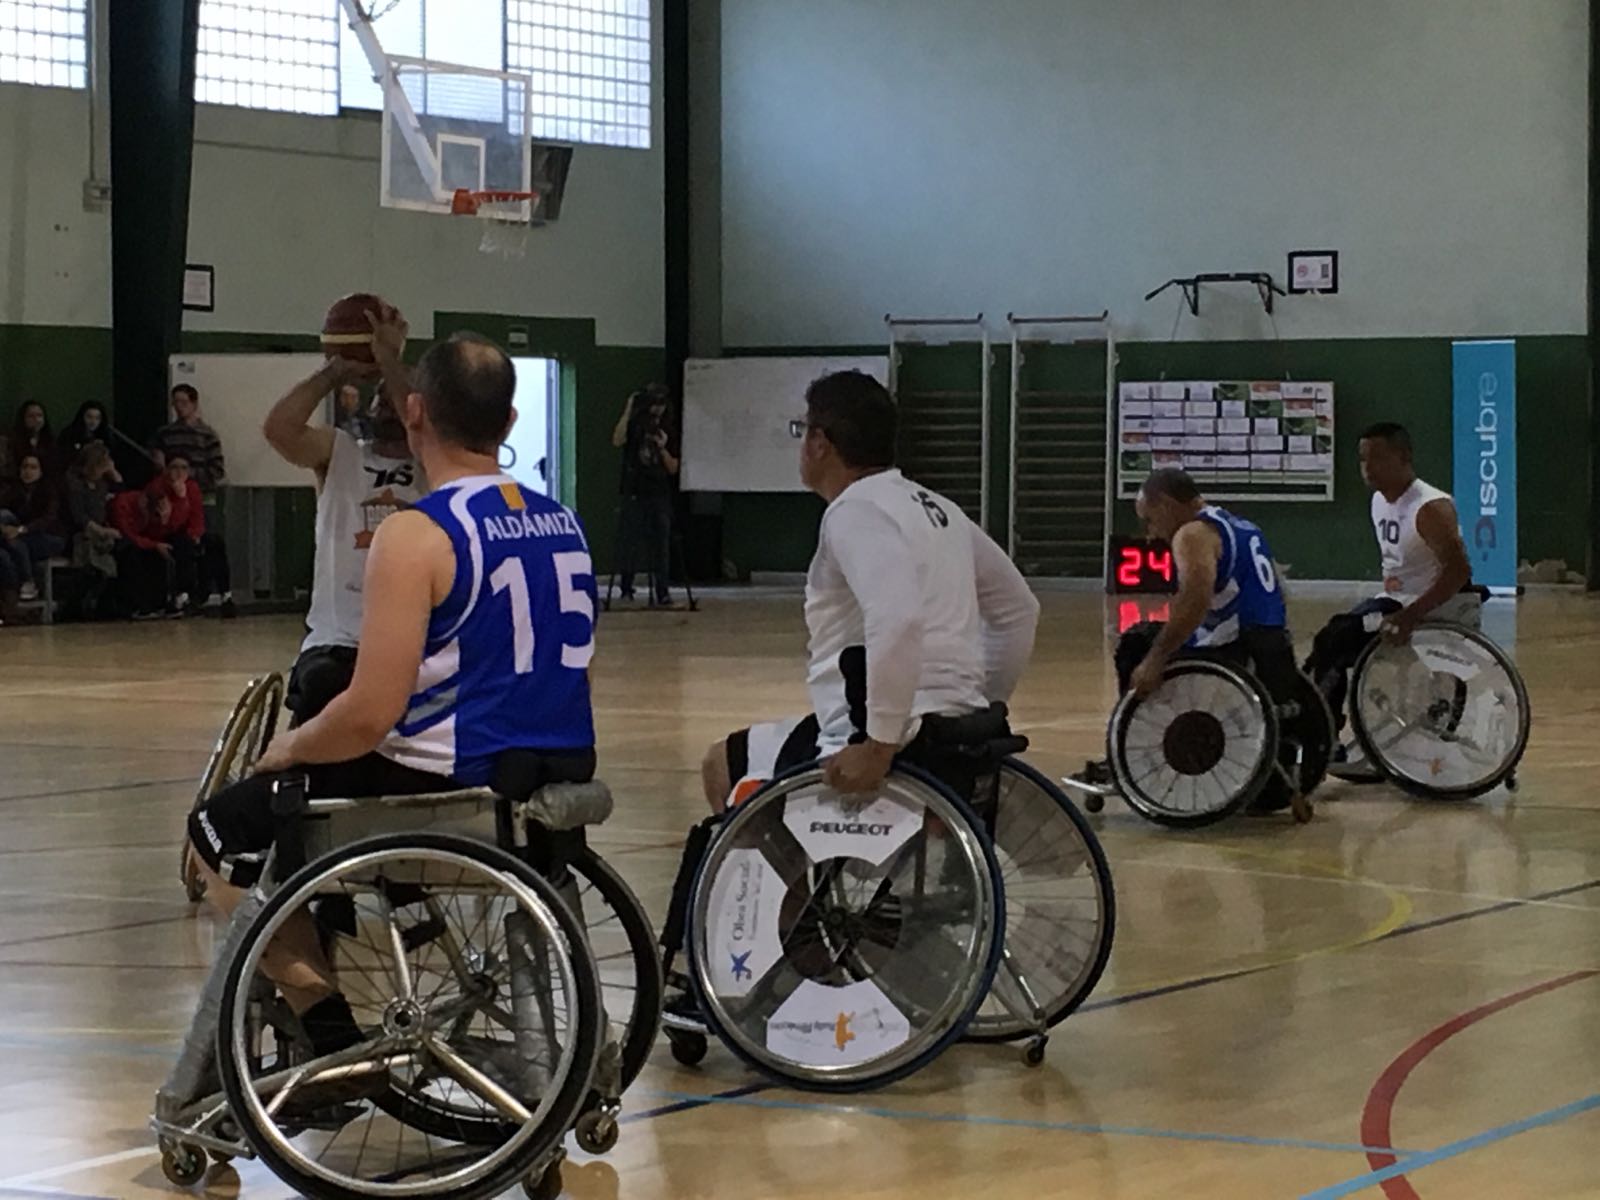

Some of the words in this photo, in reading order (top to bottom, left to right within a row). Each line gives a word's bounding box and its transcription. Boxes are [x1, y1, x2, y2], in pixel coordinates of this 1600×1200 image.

[1378, 518, 1400, 545] 10
[1118, 547, 1172, 587] 24
[1249, 535, 1275, 594] 6
[489, 550, 595, 675] 15
[809, 821, 893, 836] PEUGEOT
